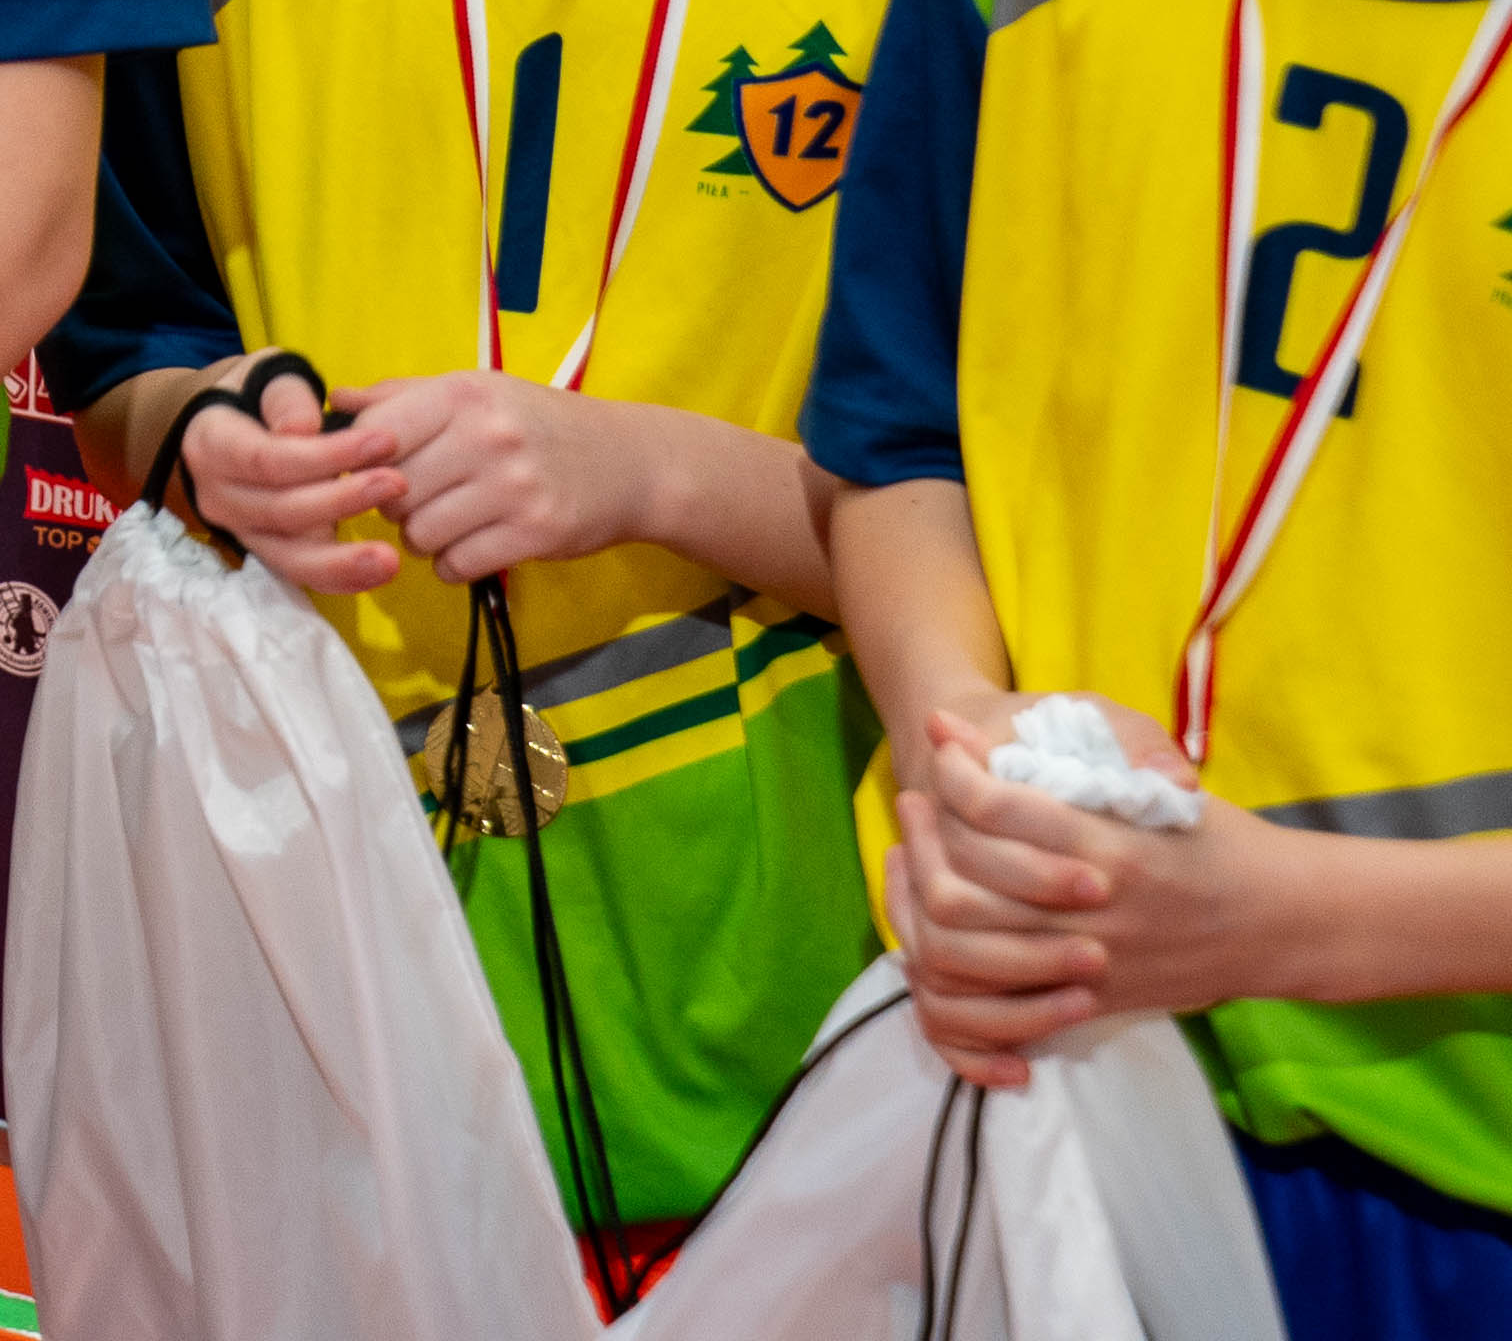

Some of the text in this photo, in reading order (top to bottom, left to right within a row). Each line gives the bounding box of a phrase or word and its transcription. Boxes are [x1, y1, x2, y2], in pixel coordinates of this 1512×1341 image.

[498, 31, 563, 313] 1
[768, 95, 845, 160] 12
[1237, 63, 1409, 418] 2
[33, 525, 84, 550] TOP
